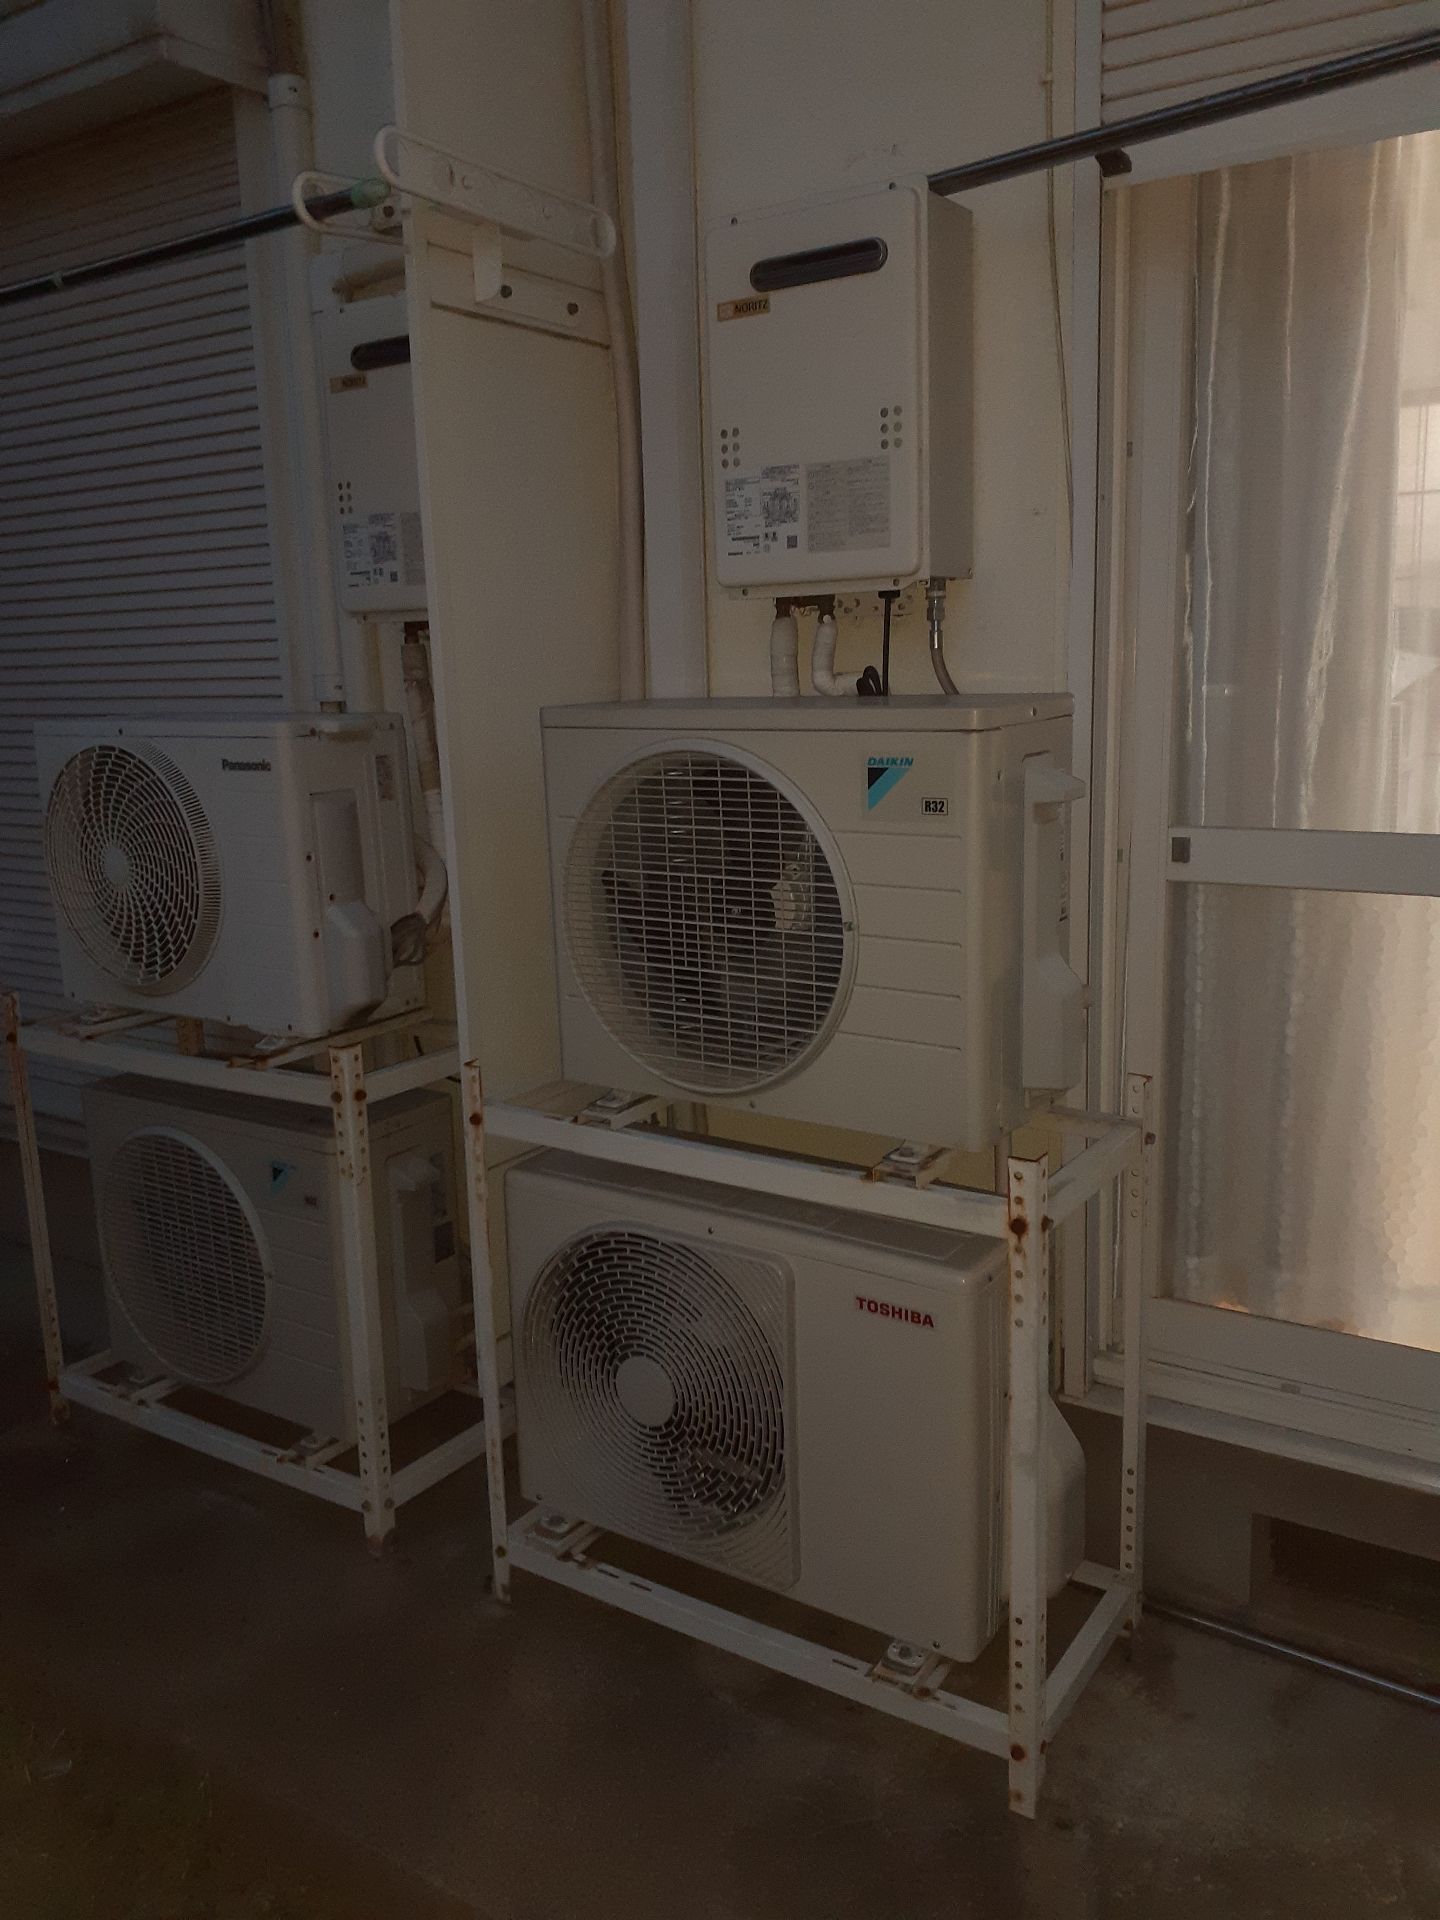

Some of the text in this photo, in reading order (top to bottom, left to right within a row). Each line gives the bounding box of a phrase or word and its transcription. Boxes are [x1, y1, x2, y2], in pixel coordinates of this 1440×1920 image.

[735, 298, 768, 313] NORITZ
[221, 758, 271, 771] Panasonic
[867, 757, 914, 766] DAIKIN
[924, 800, 945, 813] R32
[856, 1296, 934, 1328] TOSHIBA
